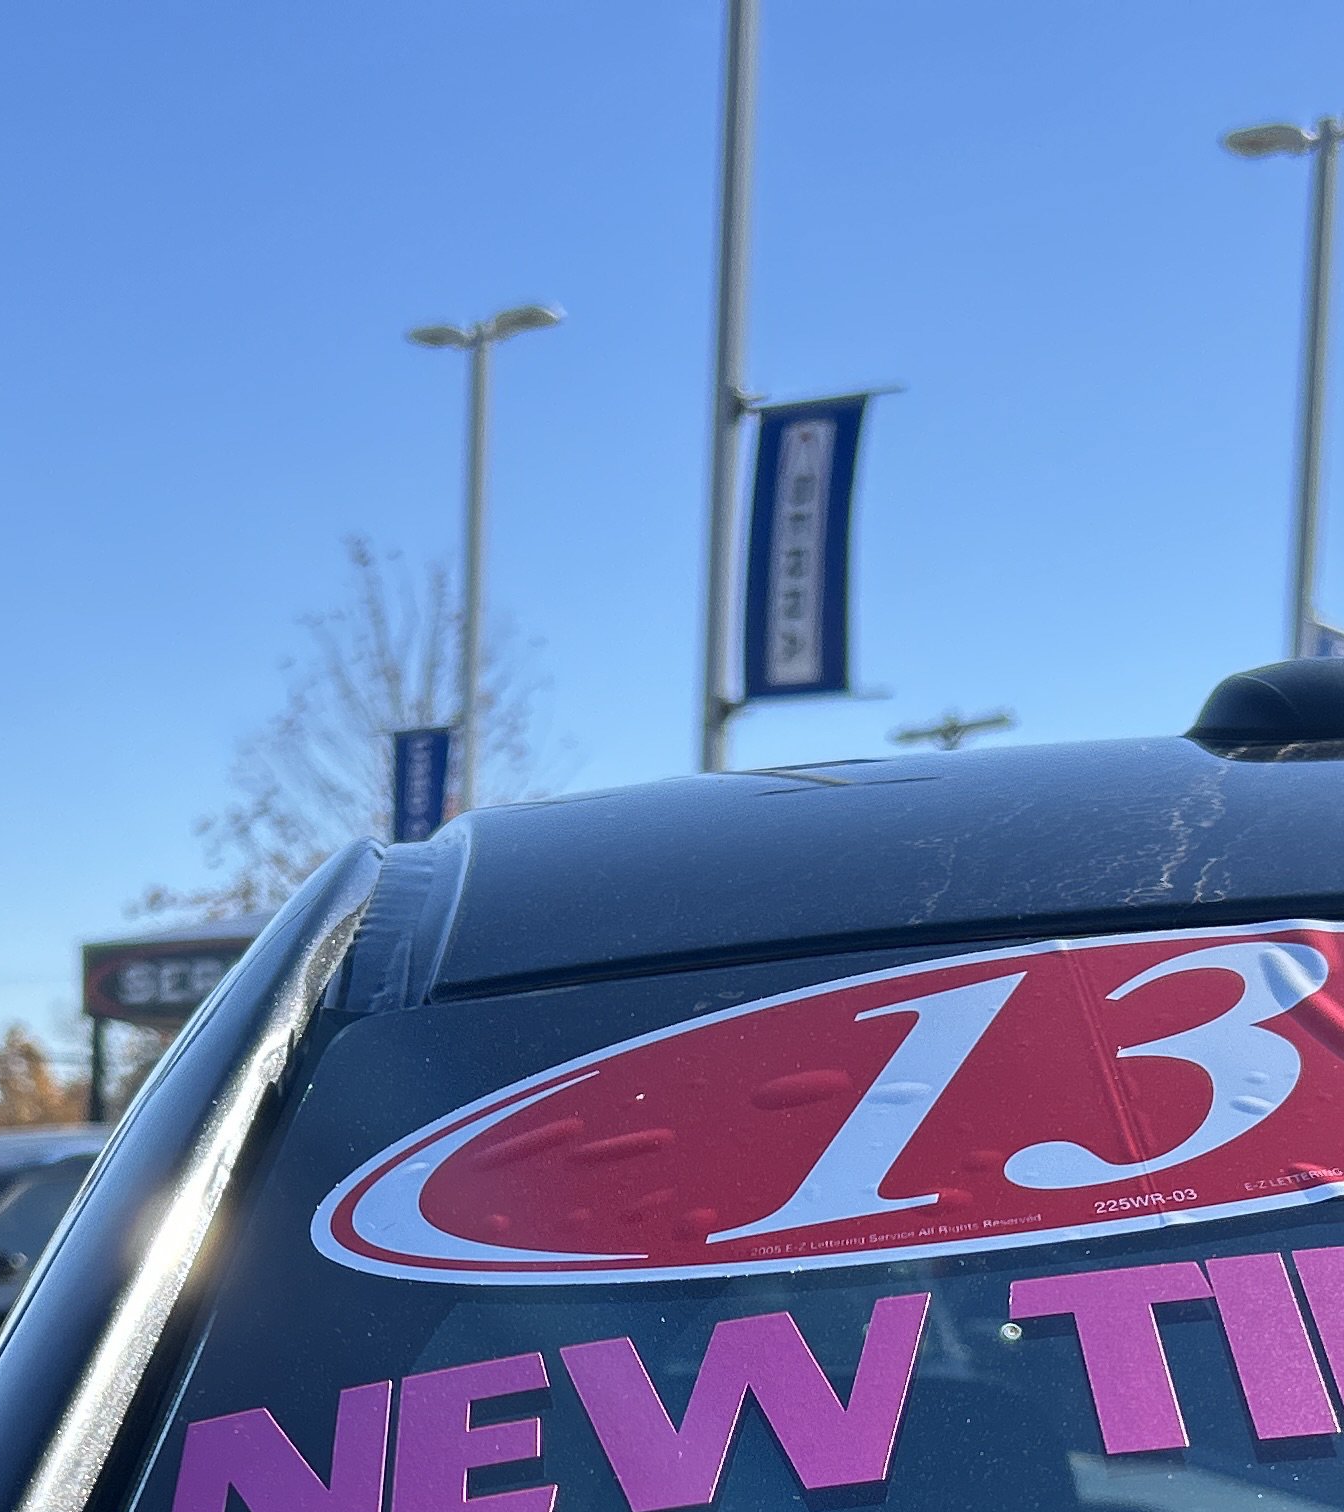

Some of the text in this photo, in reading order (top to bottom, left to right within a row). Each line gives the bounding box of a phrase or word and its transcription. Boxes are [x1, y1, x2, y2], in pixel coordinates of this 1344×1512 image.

[707, 942, 1329, 1243] 13
[1269, 1167, 1344, 1188] LETTERING
[1094, 1188, 1198, 1214] 225WR-03
[810, 1236, 866, 1250] Lettering
[868, 1230, 915, 1244] Service
[918, 1226, 935, 1237] All
[938, 1221, 979, 1235] Rights
[982, 1213, 1042, 1229] Reserved
